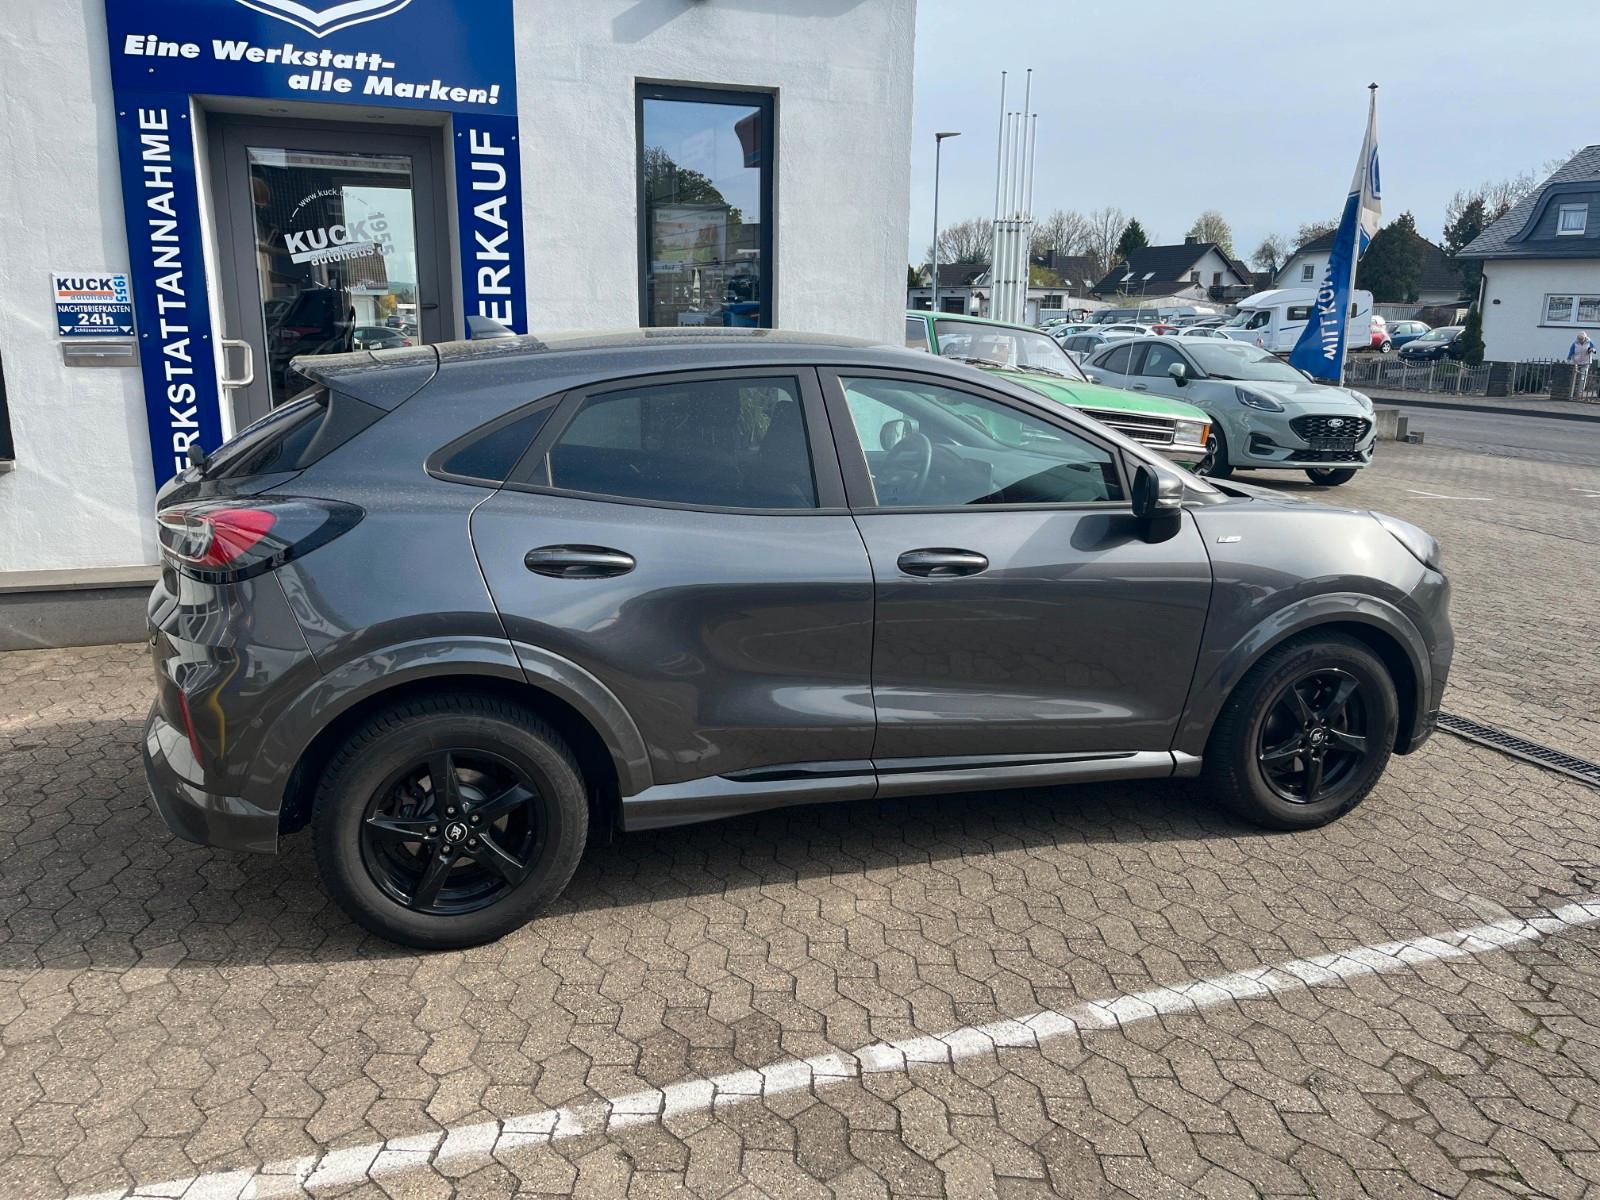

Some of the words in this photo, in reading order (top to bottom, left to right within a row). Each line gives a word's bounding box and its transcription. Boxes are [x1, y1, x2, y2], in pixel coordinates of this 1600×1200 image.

[124, 34, 201, 59] Eine
[212, 40, 396, 71] Werkstatt-
[288, 71, 353, 94] alle
[363, 77, 501, 105] Marken!
[284, 221, 373, 254] KUCK
[367, 211, 395, 257] 1955
[310, 244, 375, 266] autohaus
[56, 278, 113, 291] KUCK
[112, 275, 128, 303] 1955
[57, 305, 131, 313] NACHTBRIEFKASTEN
[78, 313, 114, 325] 24h
